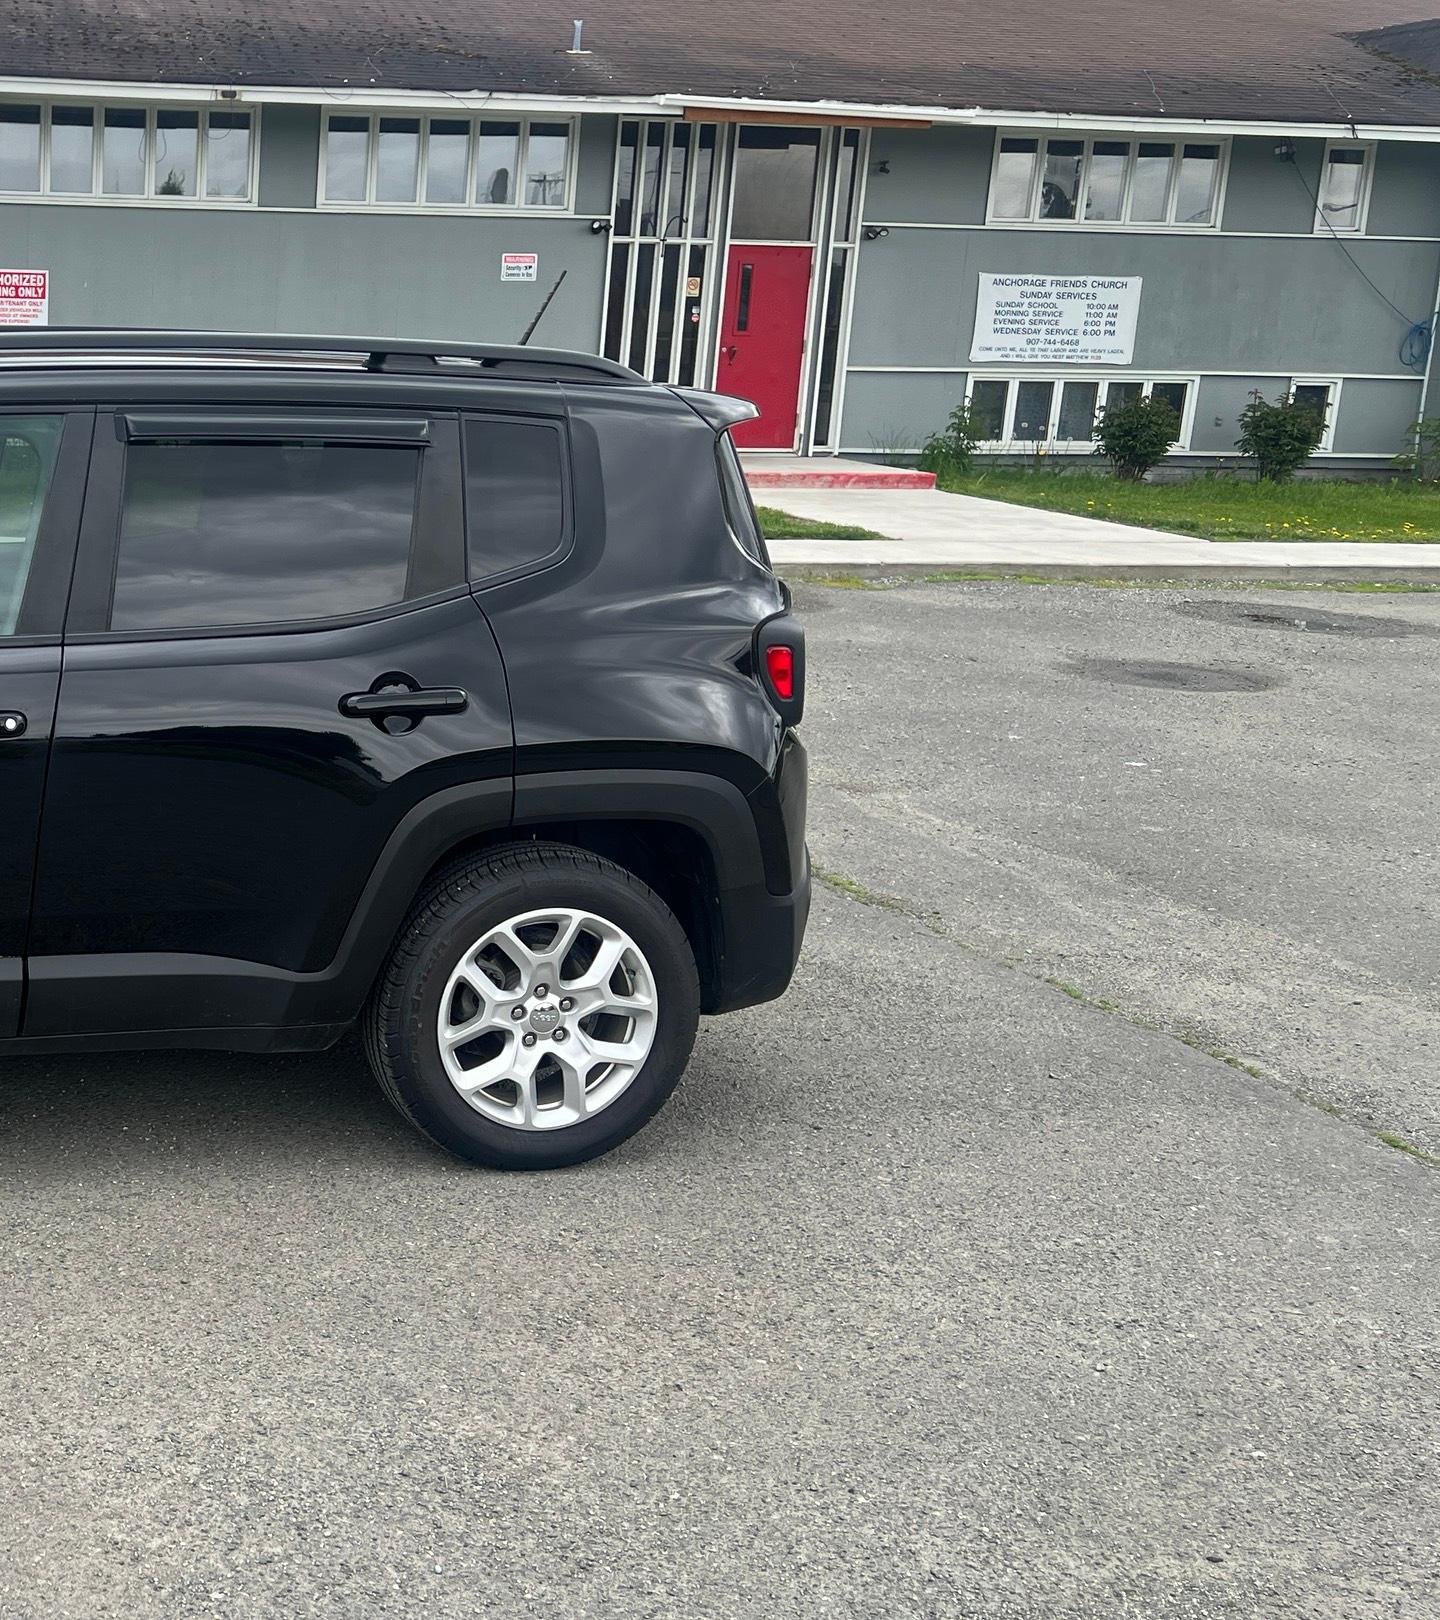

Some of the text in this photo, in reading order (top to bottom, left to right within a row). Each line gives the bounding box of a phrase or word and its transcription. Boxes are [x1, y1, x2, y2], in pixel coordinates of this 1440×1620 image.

[992, 278, 1128, 289] ANCHORAGE FRIENDS CHURCH
[18, 287, 44, 298] ONLY
[1020, 291, 1097, 300] SUNDAY SERVICES
[1026, 338, 1080, 346] 907-744-6468
